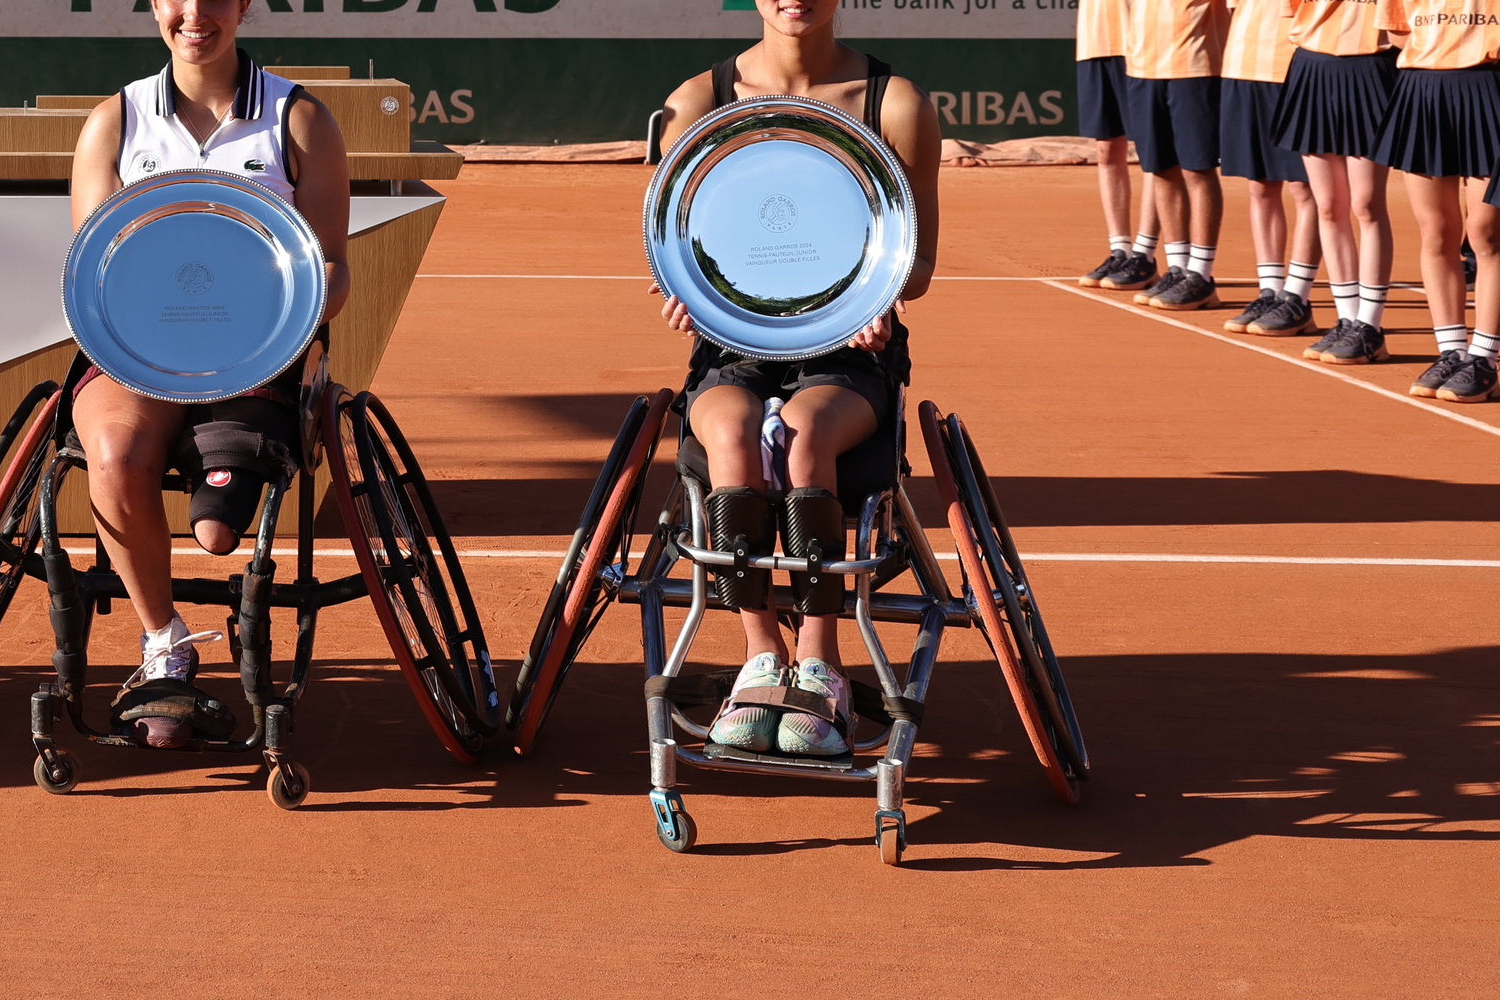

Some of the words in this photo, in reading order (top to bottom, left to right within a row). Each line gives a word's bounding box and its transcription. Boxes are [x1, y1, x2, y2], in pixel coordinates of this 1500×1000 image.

[1414, 15, 1436, 27] BNP
[1437, 13, 1499, 26] PARIBA
[760, 196, 776, 220] ROLAND
[777, 196, 796, 217] GARROS
[767, 221, 792, 231] PARIS
[748, 251, 795, 259] TENNIS-FAUTEUIL
[745, 258, 778, 266] VAINQUEUR
[177, 263, 194, 282] ROLAND
[195, 263, 212, 282] GARROS
